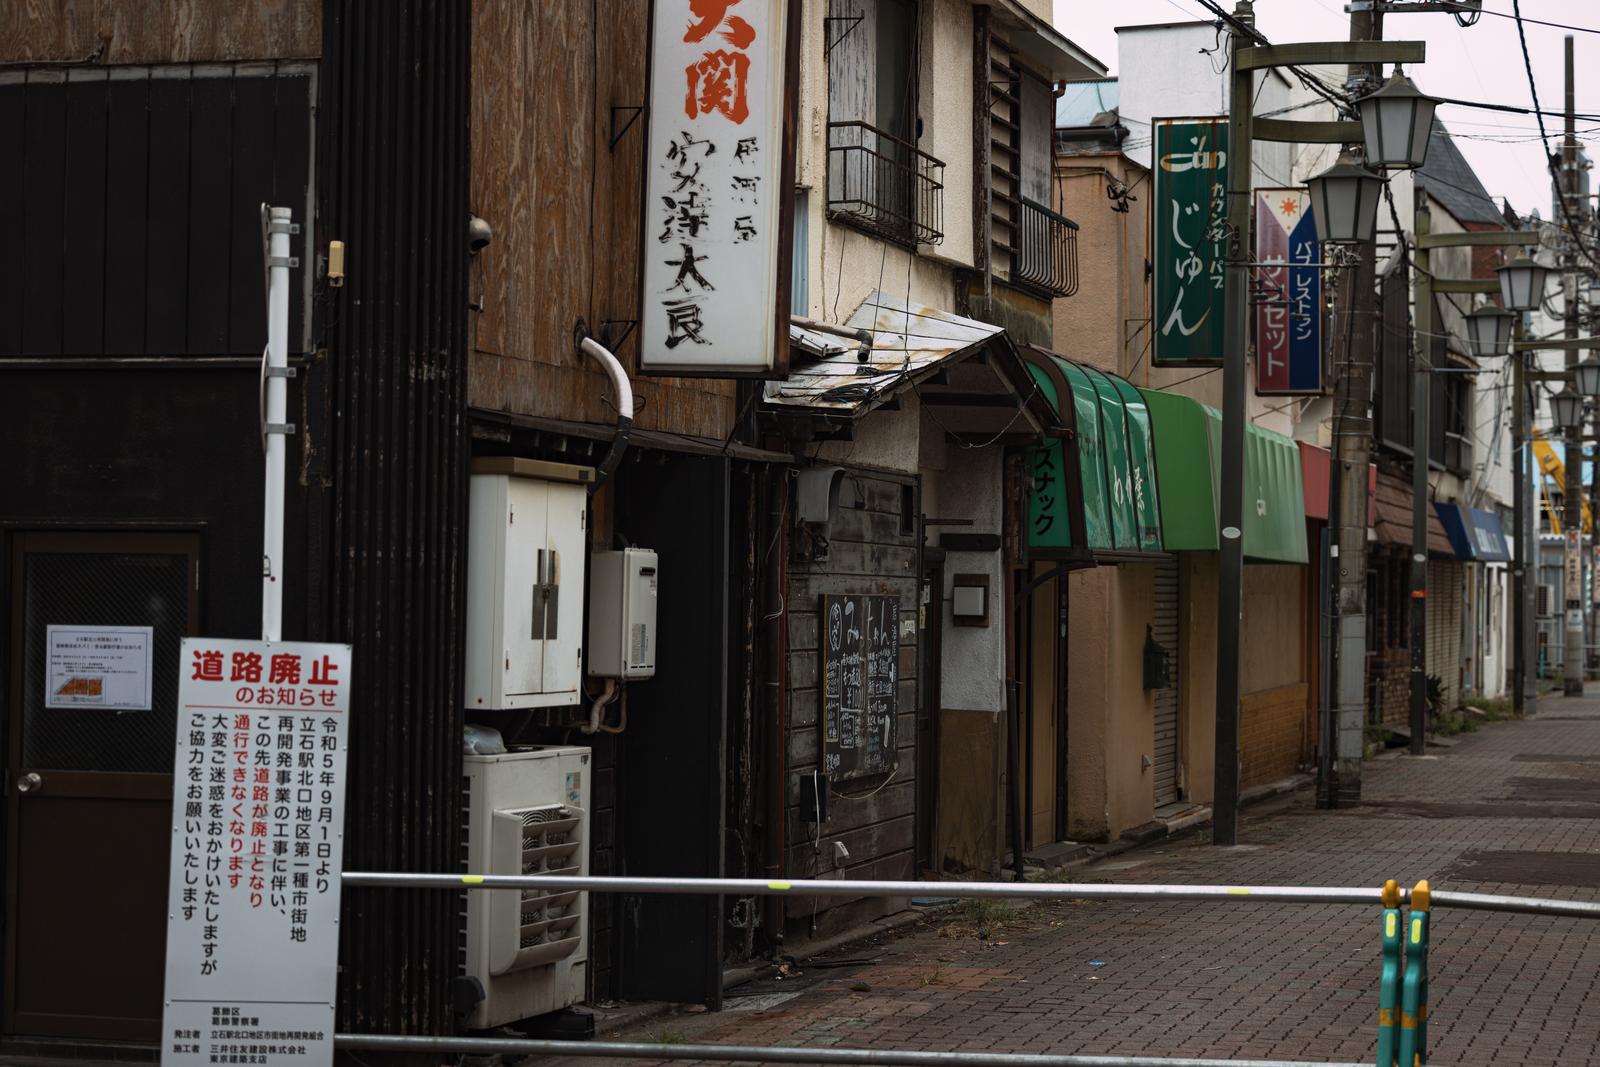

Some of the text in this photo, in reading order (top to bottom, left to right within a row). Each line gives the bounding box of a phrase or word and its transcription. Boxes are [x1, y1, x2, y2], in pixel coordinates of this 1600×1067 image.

[1161, 198, 1212, 336] じゅん
[1263, 254, 1286, 377] サンセット
[1034, 448, 1056, 536] スナック
[192, 650, 338, 685] 道路廃止
[236, 686, 338, 707] のお知らせ
[182, 713, 206, 921] ご協力をお願いいたします
[200, 713, 228, 976] 大変ご迷惑をおかけいたしますが
[227, 714, 250, 888] 通行できなくなります
[249, 716, 271, 908] この先道路が廃止となり
[270, 715, 294, 915] 再開発事業の工事に伴い、
[290, 716, 316, 943] 立石駅北口地区第一種市街地
[316, 716, 338, 894] 令和5年9月1日より
[174, 1029, 200, 1039] 発注者
[210, 1044, 306, 1055] 三井住友建設株式会社
[210, 1054, 267, 1064] 東京建築支店
